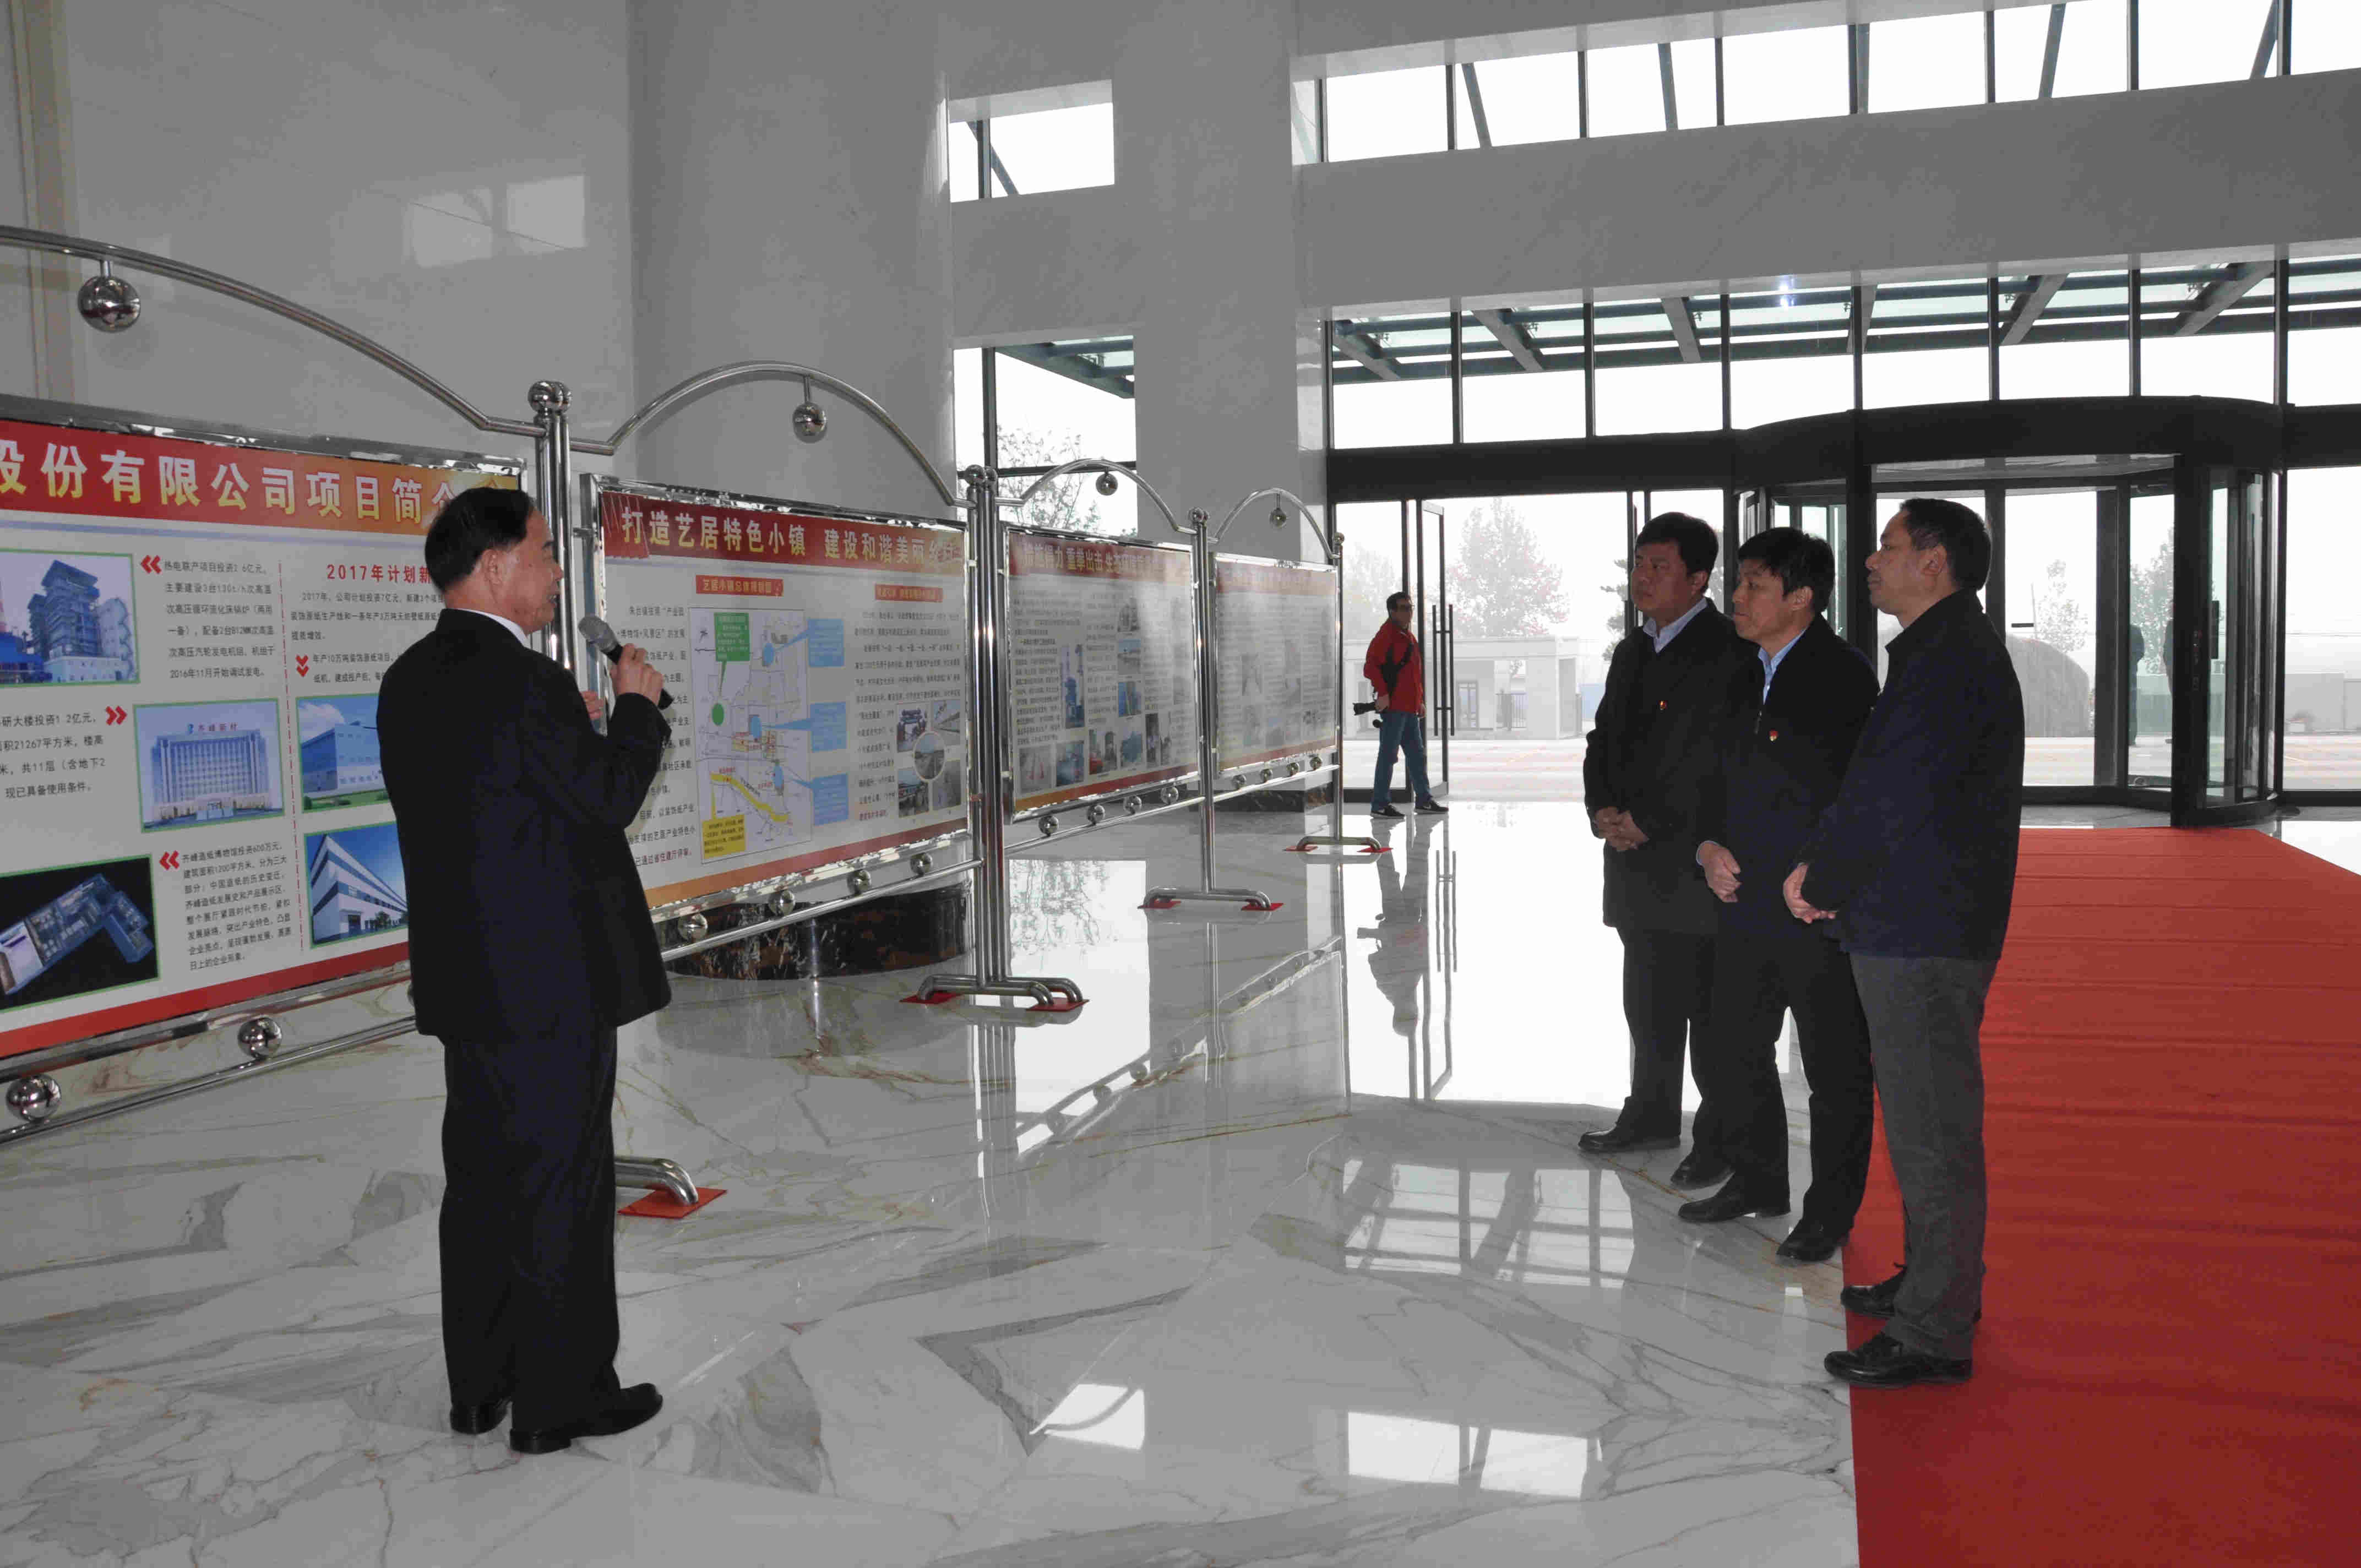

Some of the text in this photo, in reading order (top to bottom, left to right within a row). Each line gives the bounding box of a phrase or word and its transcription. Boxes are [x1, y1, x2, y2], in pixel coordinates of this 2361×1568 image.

[622, 507, 806, 556] 打造艺居特色小镇
[1067, 547, 1103, 573] 重拳出击
